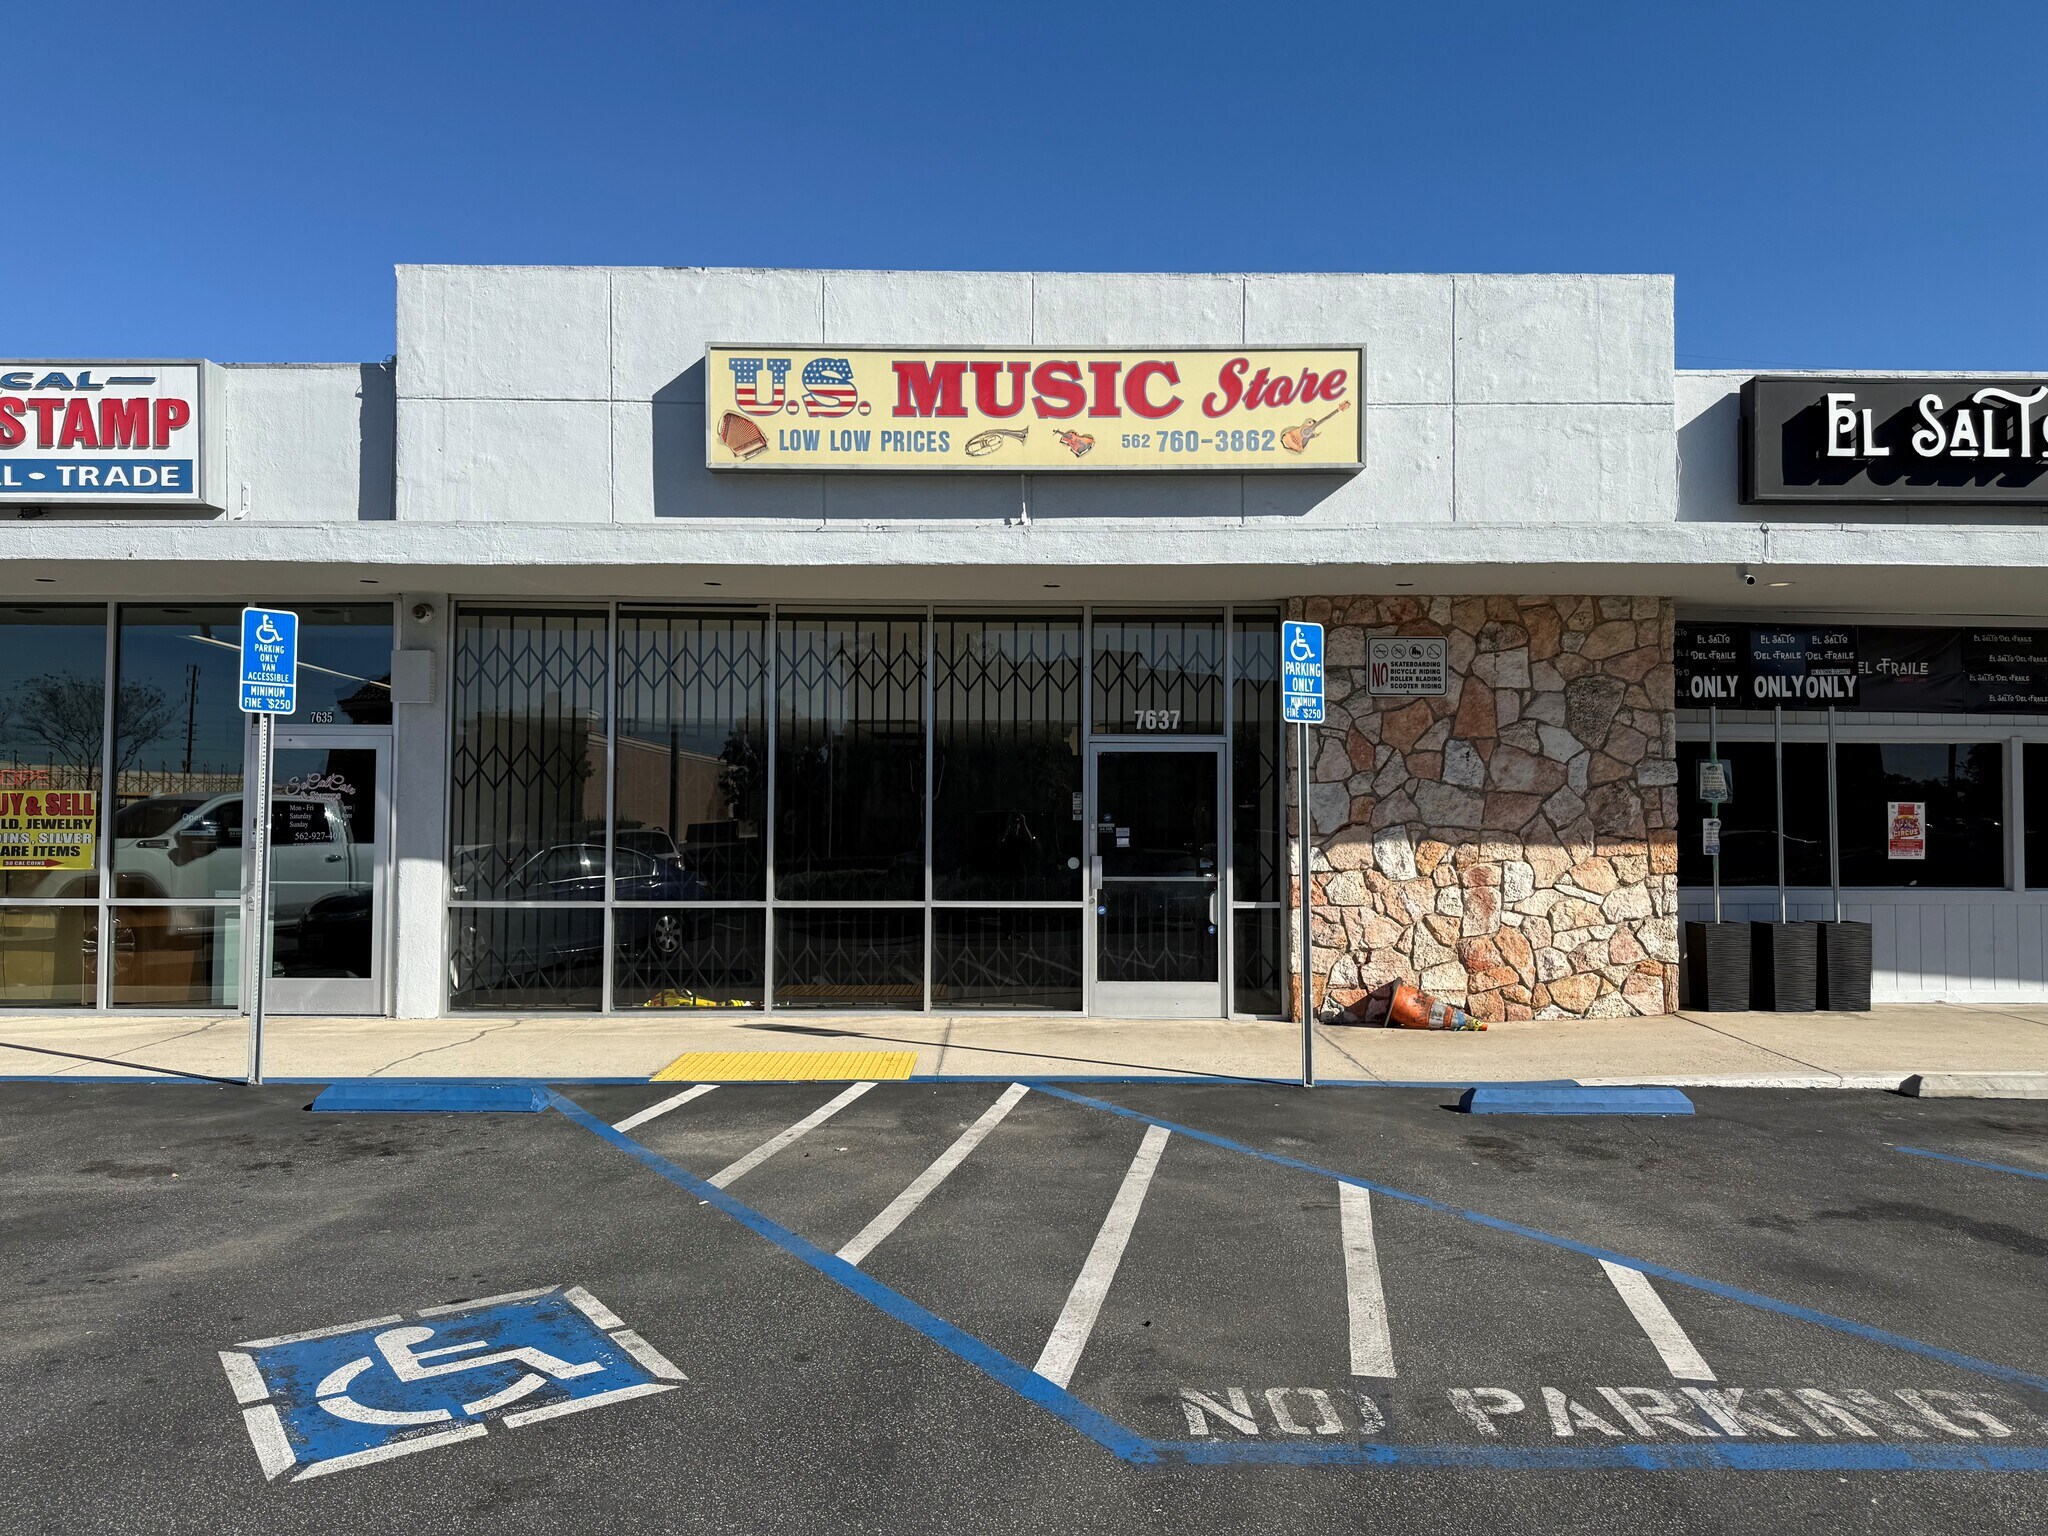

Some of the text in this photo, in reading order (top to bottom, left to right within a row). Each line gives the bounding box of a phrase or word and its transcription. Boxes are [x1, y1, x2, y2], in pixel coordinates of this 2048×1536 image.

[728, 357, 1348, 419] U.S. MUSIC Store
[0, 396, 190, 450] STAMP
[1827, 385, 2048, 457] EL SALT
[779, 429, 950, 452] LOW LOW PRICES
[1121, 430, 1275, 452] 562 760-3862
[56, 465, 180, 487] TRADE
[254, 644, 285, 654] PARKING
[260, 654, 278, 662] ONLY
[262, 663, 276, 672] VAN
[1285, 661, 1321, 677] PARKING
[1372, 662, 1388, 687] NO
[248, 672, 289, 682] ACCESSIBLE
[1292, 677, 1314, 692] ONLY
[250, 686, 285, 697] MINIMUM
[1691, 675, 1739, 698] ONLY
[1754, 675, 1804, 698] ONLY
[1805, 675, 1857, 698] ONLY
[245, 697, 290, 709] FINE $250
[311, 712, 333, 723] 7635
[1134, 710, 1181, 730] 7637
[1303, 708, 1321, 719] $250
[25, 796, 42, 816] &
[45, 793, 95, 816] SELL
[26, 818, 93, 830] JEWELRY
[289, 821, 309, 829] Sunday
[0, 832, 93, 845] INS, SILVER
[33, 846, 80, 857] ITEMS
[1180, 1386, 2012, 1437] NO PARKING
